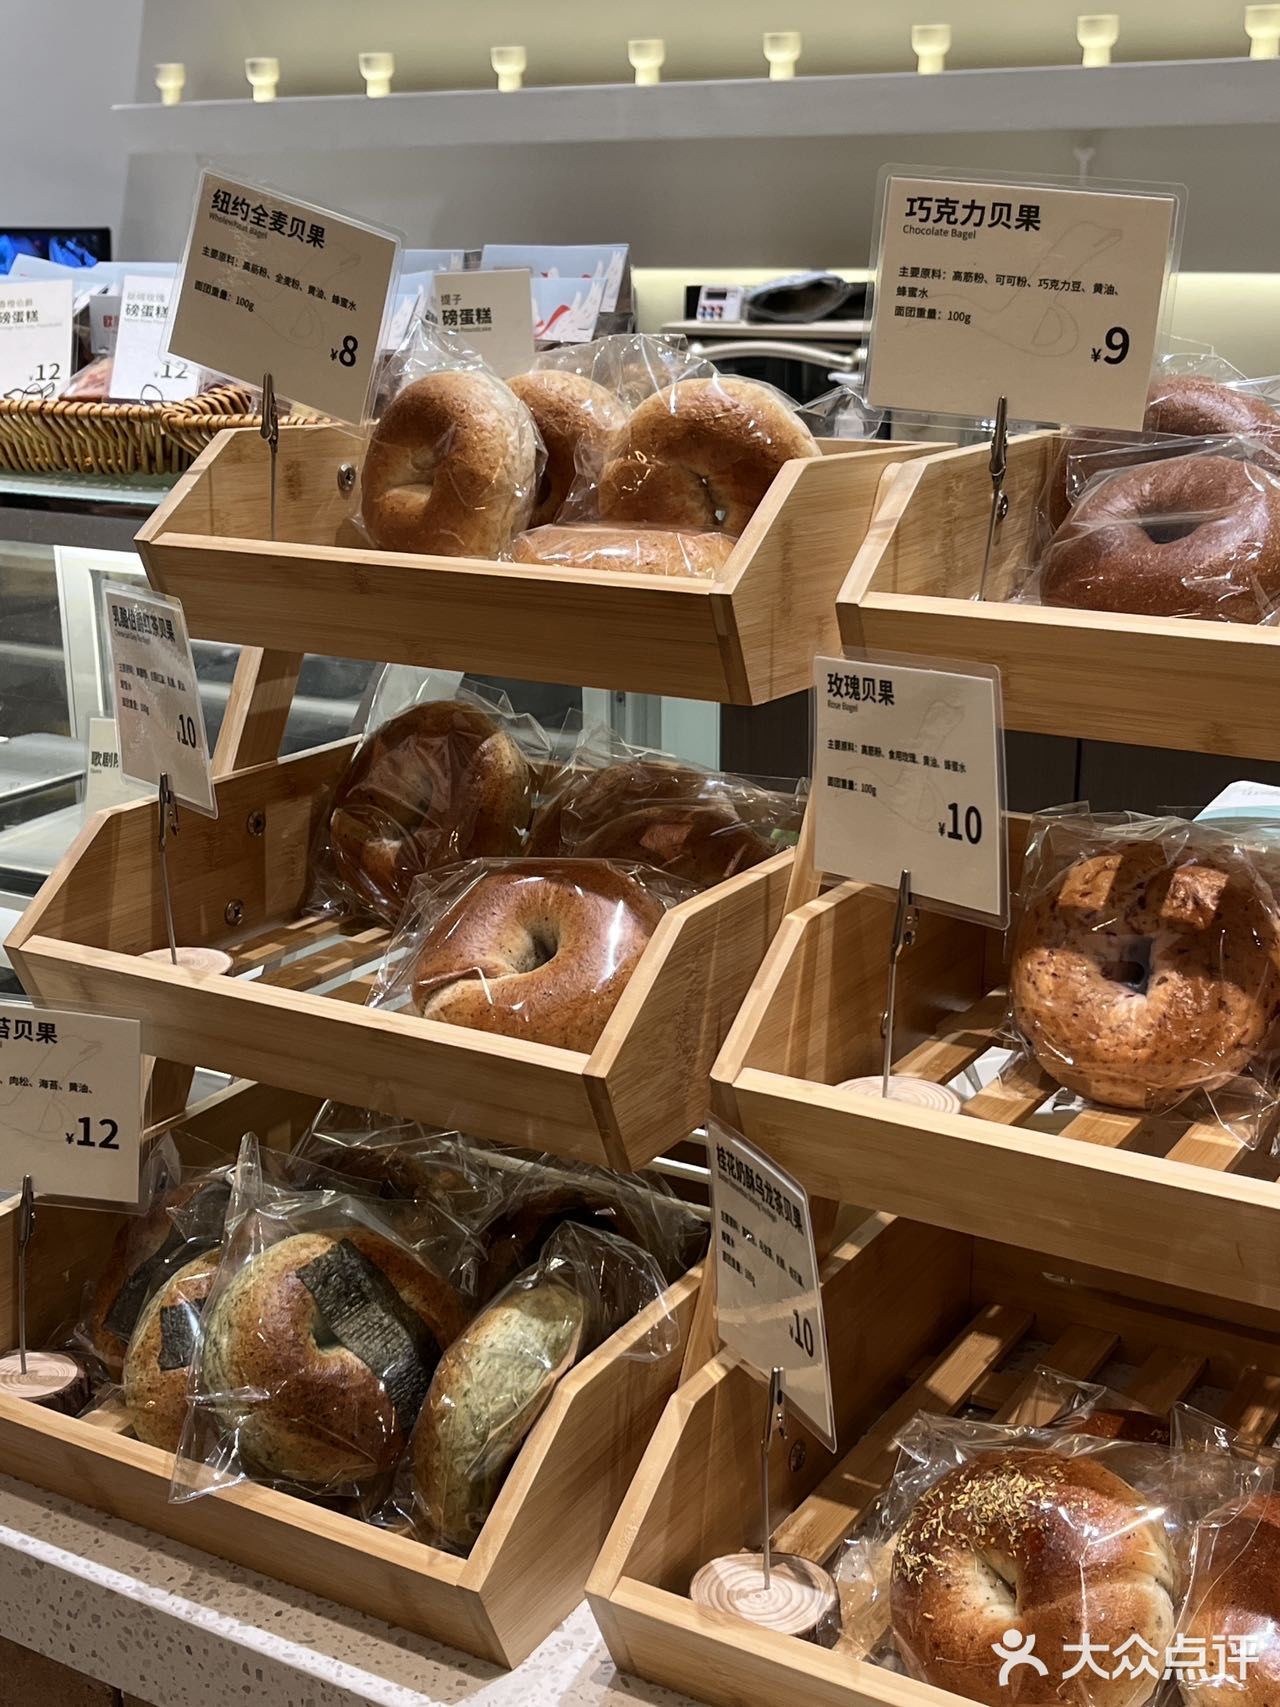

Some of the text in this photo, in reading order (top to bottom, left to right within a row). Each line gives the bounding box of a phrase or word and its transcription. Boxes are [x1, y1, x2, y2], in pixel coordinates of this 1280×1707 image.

[211, 189, 326, 249] 纽约全麦贝果
[905, 196, 1041, 232] 巧克力贝果
[902, 224, 977, 241] Chocolate Bagel
[896, 286, 929, 299] 蜂蜜水
[126, 303, 169, 319] 磅蛋糕
[442, 307, 492, 326] 磅蛋糕
[330, 334, 359, 367] ¥8
[1091, 326, 1131, 365] ¥9
[827, 672, 895, 707] 玫瑰贝果
[938, 802, 982, 845] ¥10
[65, 1116, 119, 1150] ¥12
